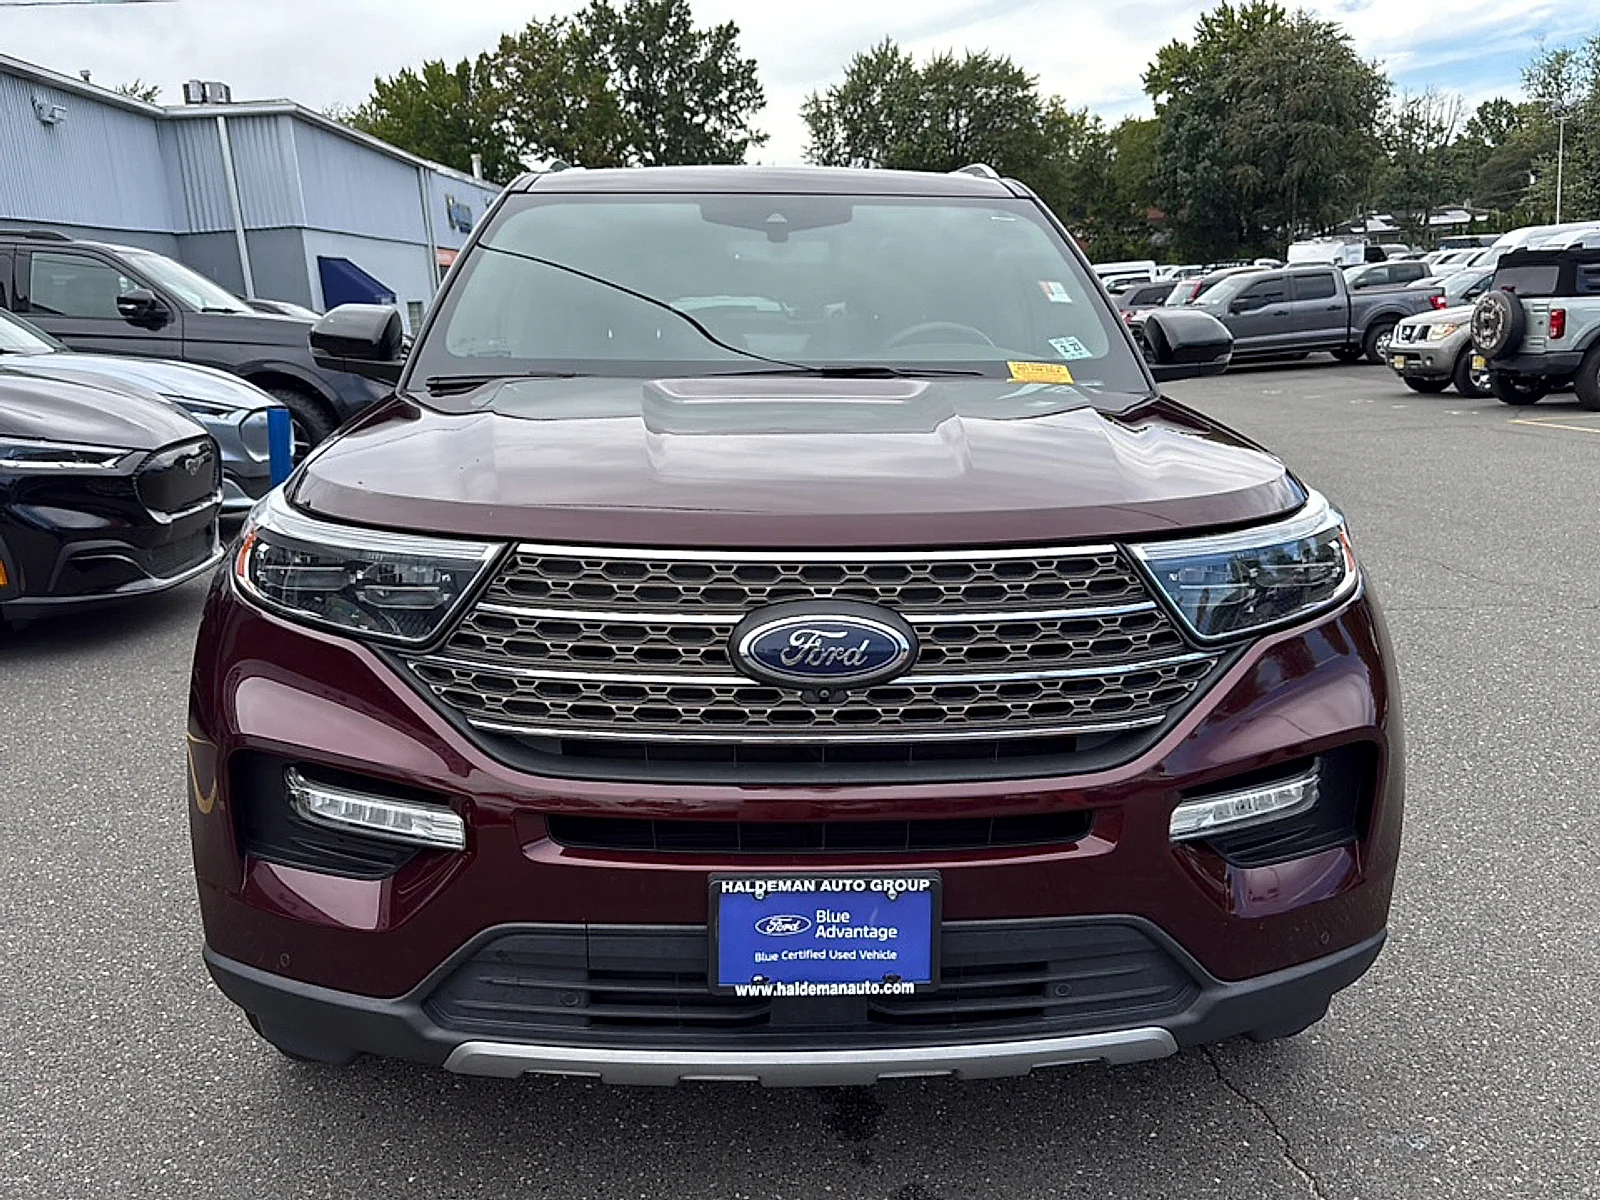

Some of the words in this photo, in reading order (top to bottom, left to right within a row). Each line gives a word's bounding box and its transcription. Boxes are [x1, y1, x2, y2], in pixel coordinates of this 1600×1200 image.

[780, 629, 870, 667] Ford
[721, 880, 816, 893] HALDEMAN
[820, 879, 866, 892] AUTO
[869, 879, 930, 892] GROUP
[816, 909, 850, 923] Blue
[766, 918, 801, 932] Ford
[814, 925, 898, 941] Advantage
[754, 951, 779, 963] Blue
[781, 949, 827, 961] Certified
[829, 949, 857, 960] Used
[859, 949, 898, 960] Vehicle
[734, 981, 915, 997] www.haldemanauto.com
